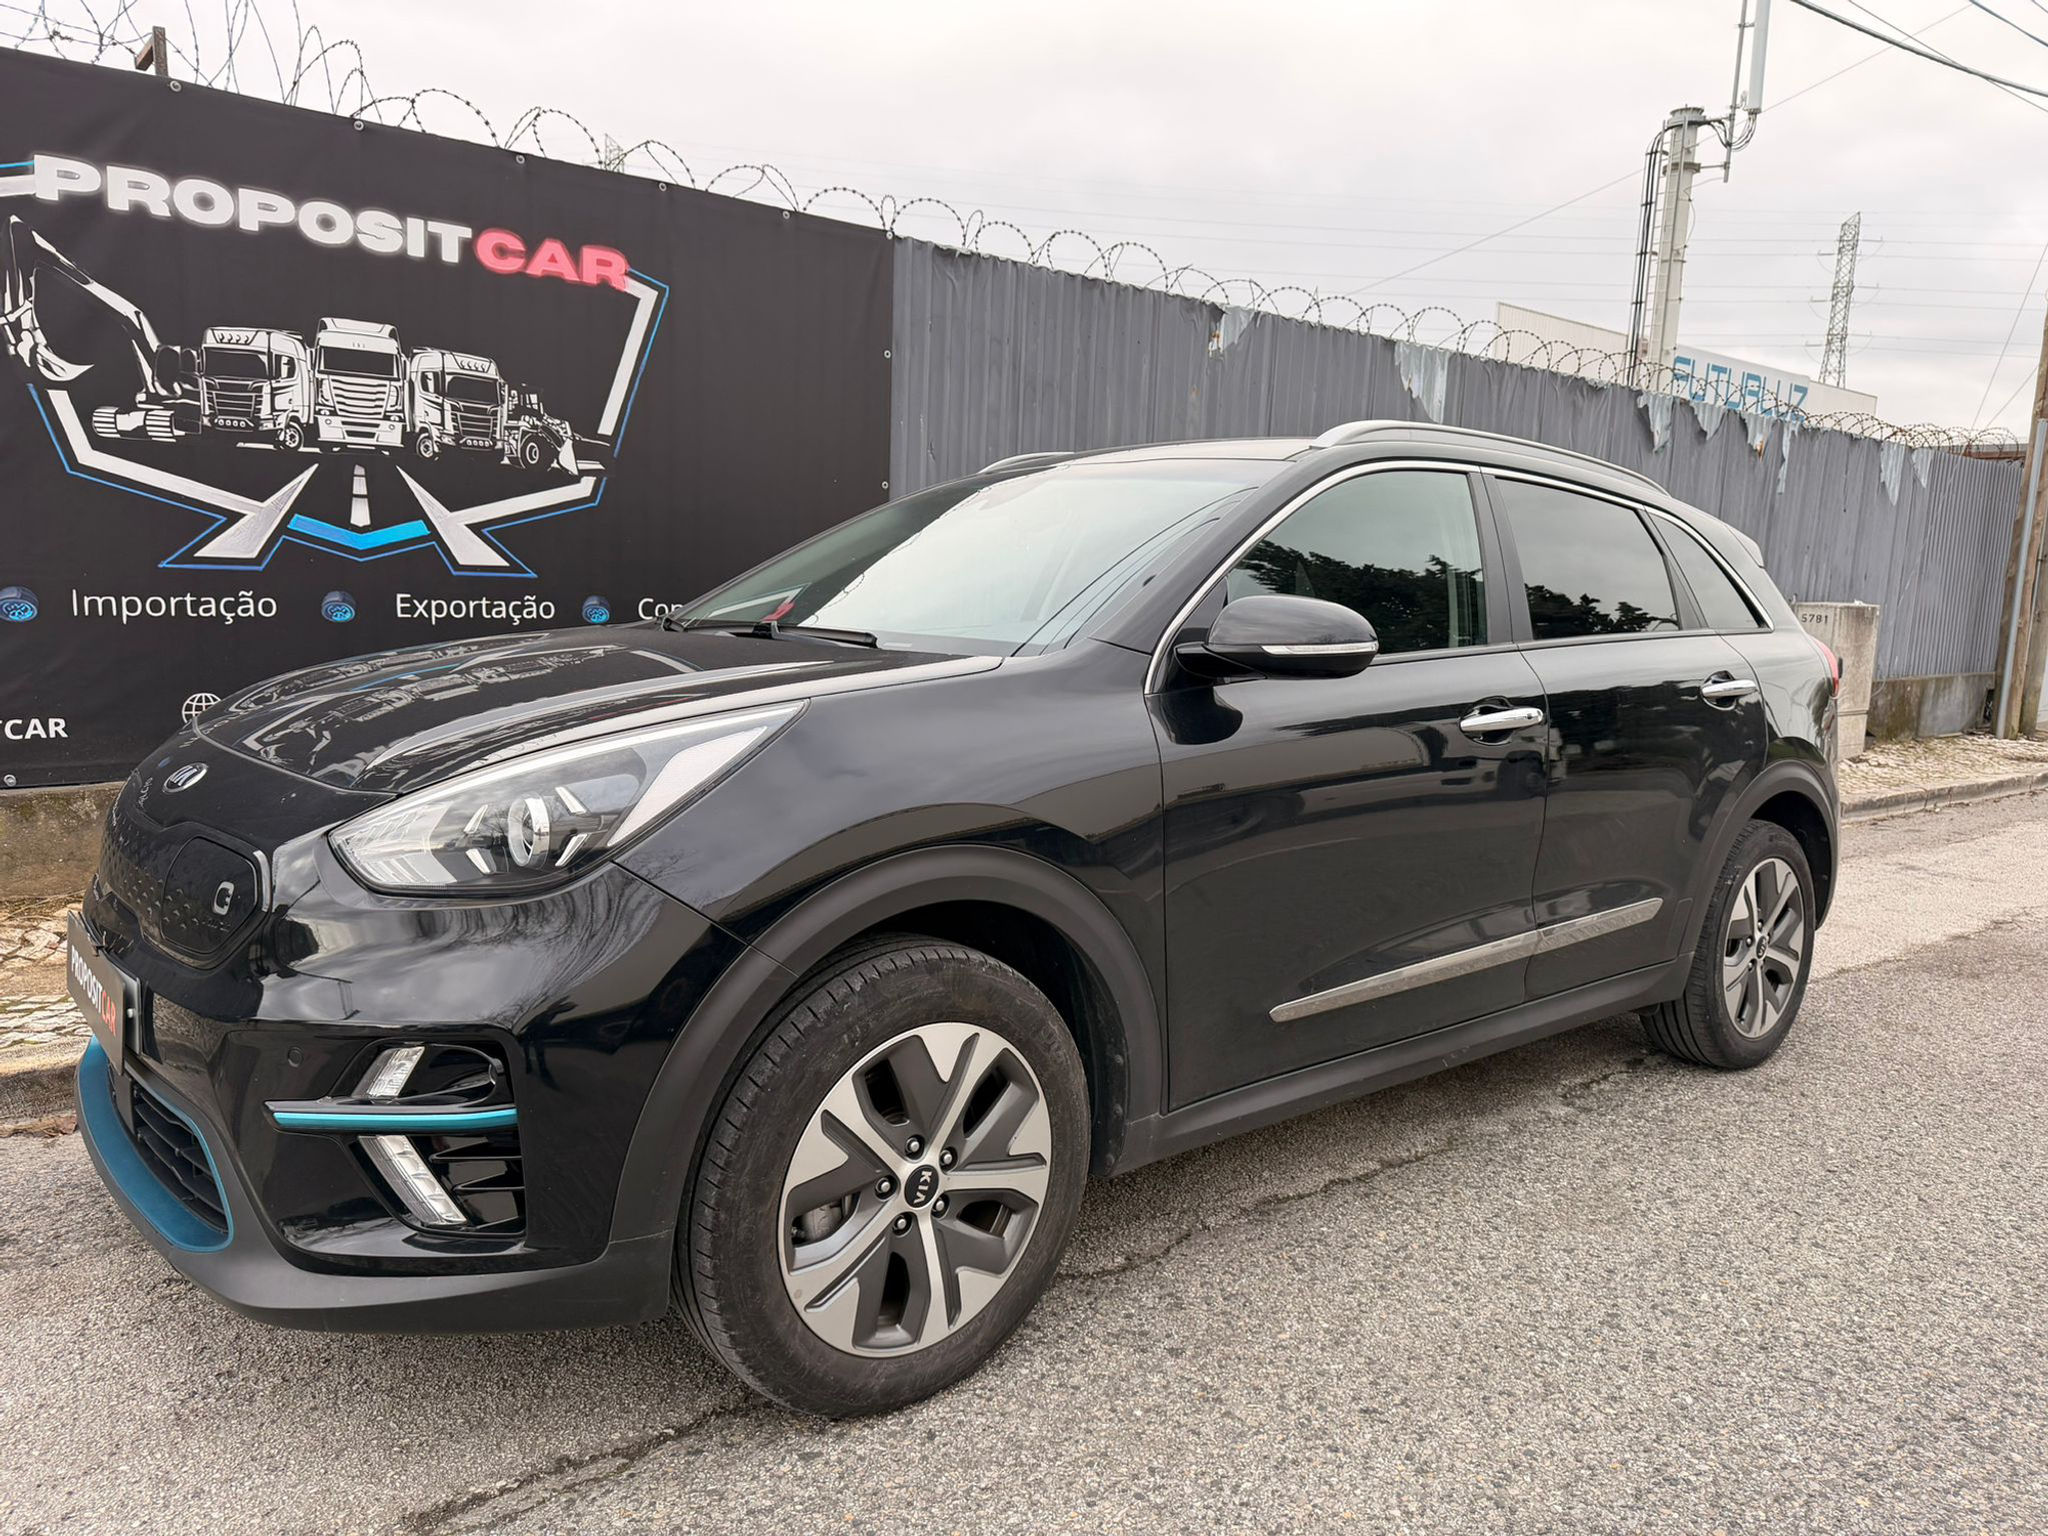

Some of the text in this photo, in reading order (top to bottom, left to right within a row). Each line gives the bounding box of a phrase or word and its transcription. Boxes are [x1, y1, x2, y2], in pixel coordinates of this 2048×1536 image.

[34, 154, 630, 291] PROPOSITCAR
[72, 589, 277, 625] Importação
[395, 593, 556, 625] Exportação
[1801, 613, 1829, 624] 5781
[0, 718, 68, 740] CAR
[71, 945, 117, 1037] PROPOSITCAR
[913, 1170, 932, 1204] KIA
